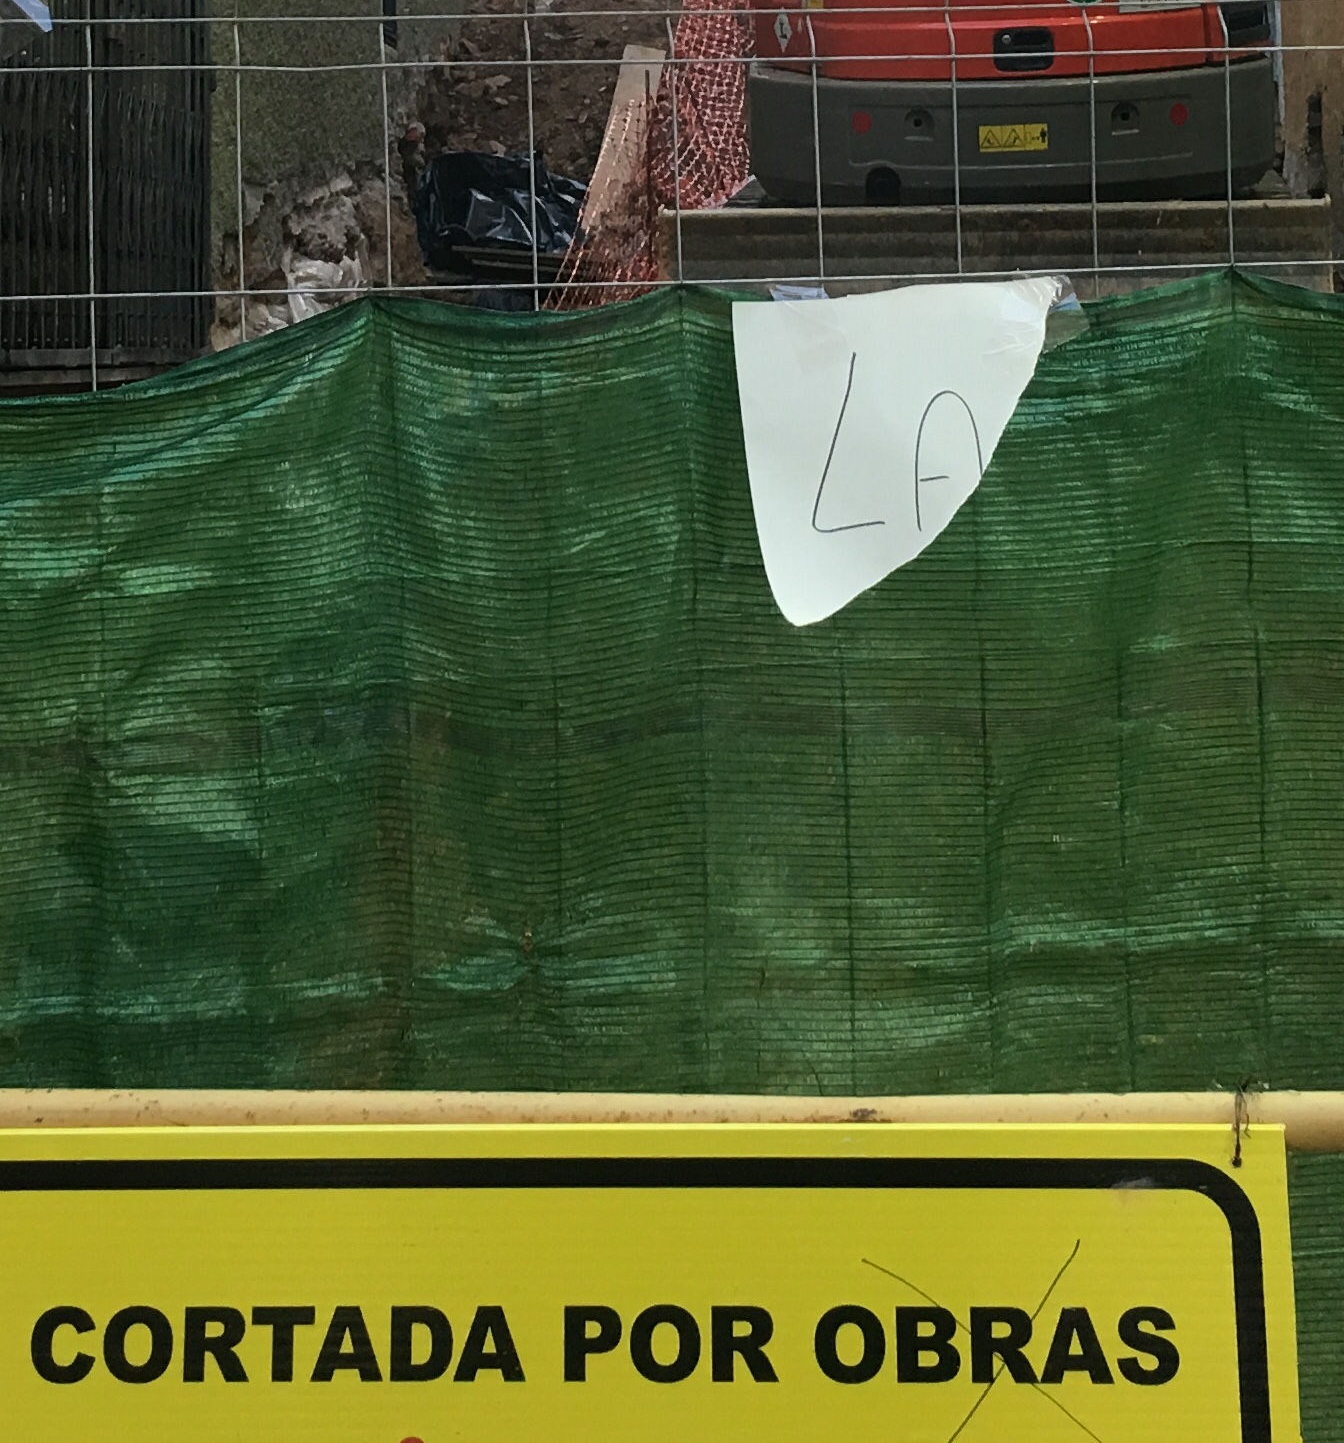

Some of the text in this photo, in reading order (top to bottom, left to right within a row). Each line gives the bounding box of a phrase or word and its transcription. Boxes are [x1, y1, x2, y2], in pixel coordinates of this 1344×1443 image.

[812, 351, 983, 533] LA
[29, 1305, 525, 1385] CORTADA
[563, 1304, 780, 1384] POR
[813, 1305, 1182, 1386] OBRAS
